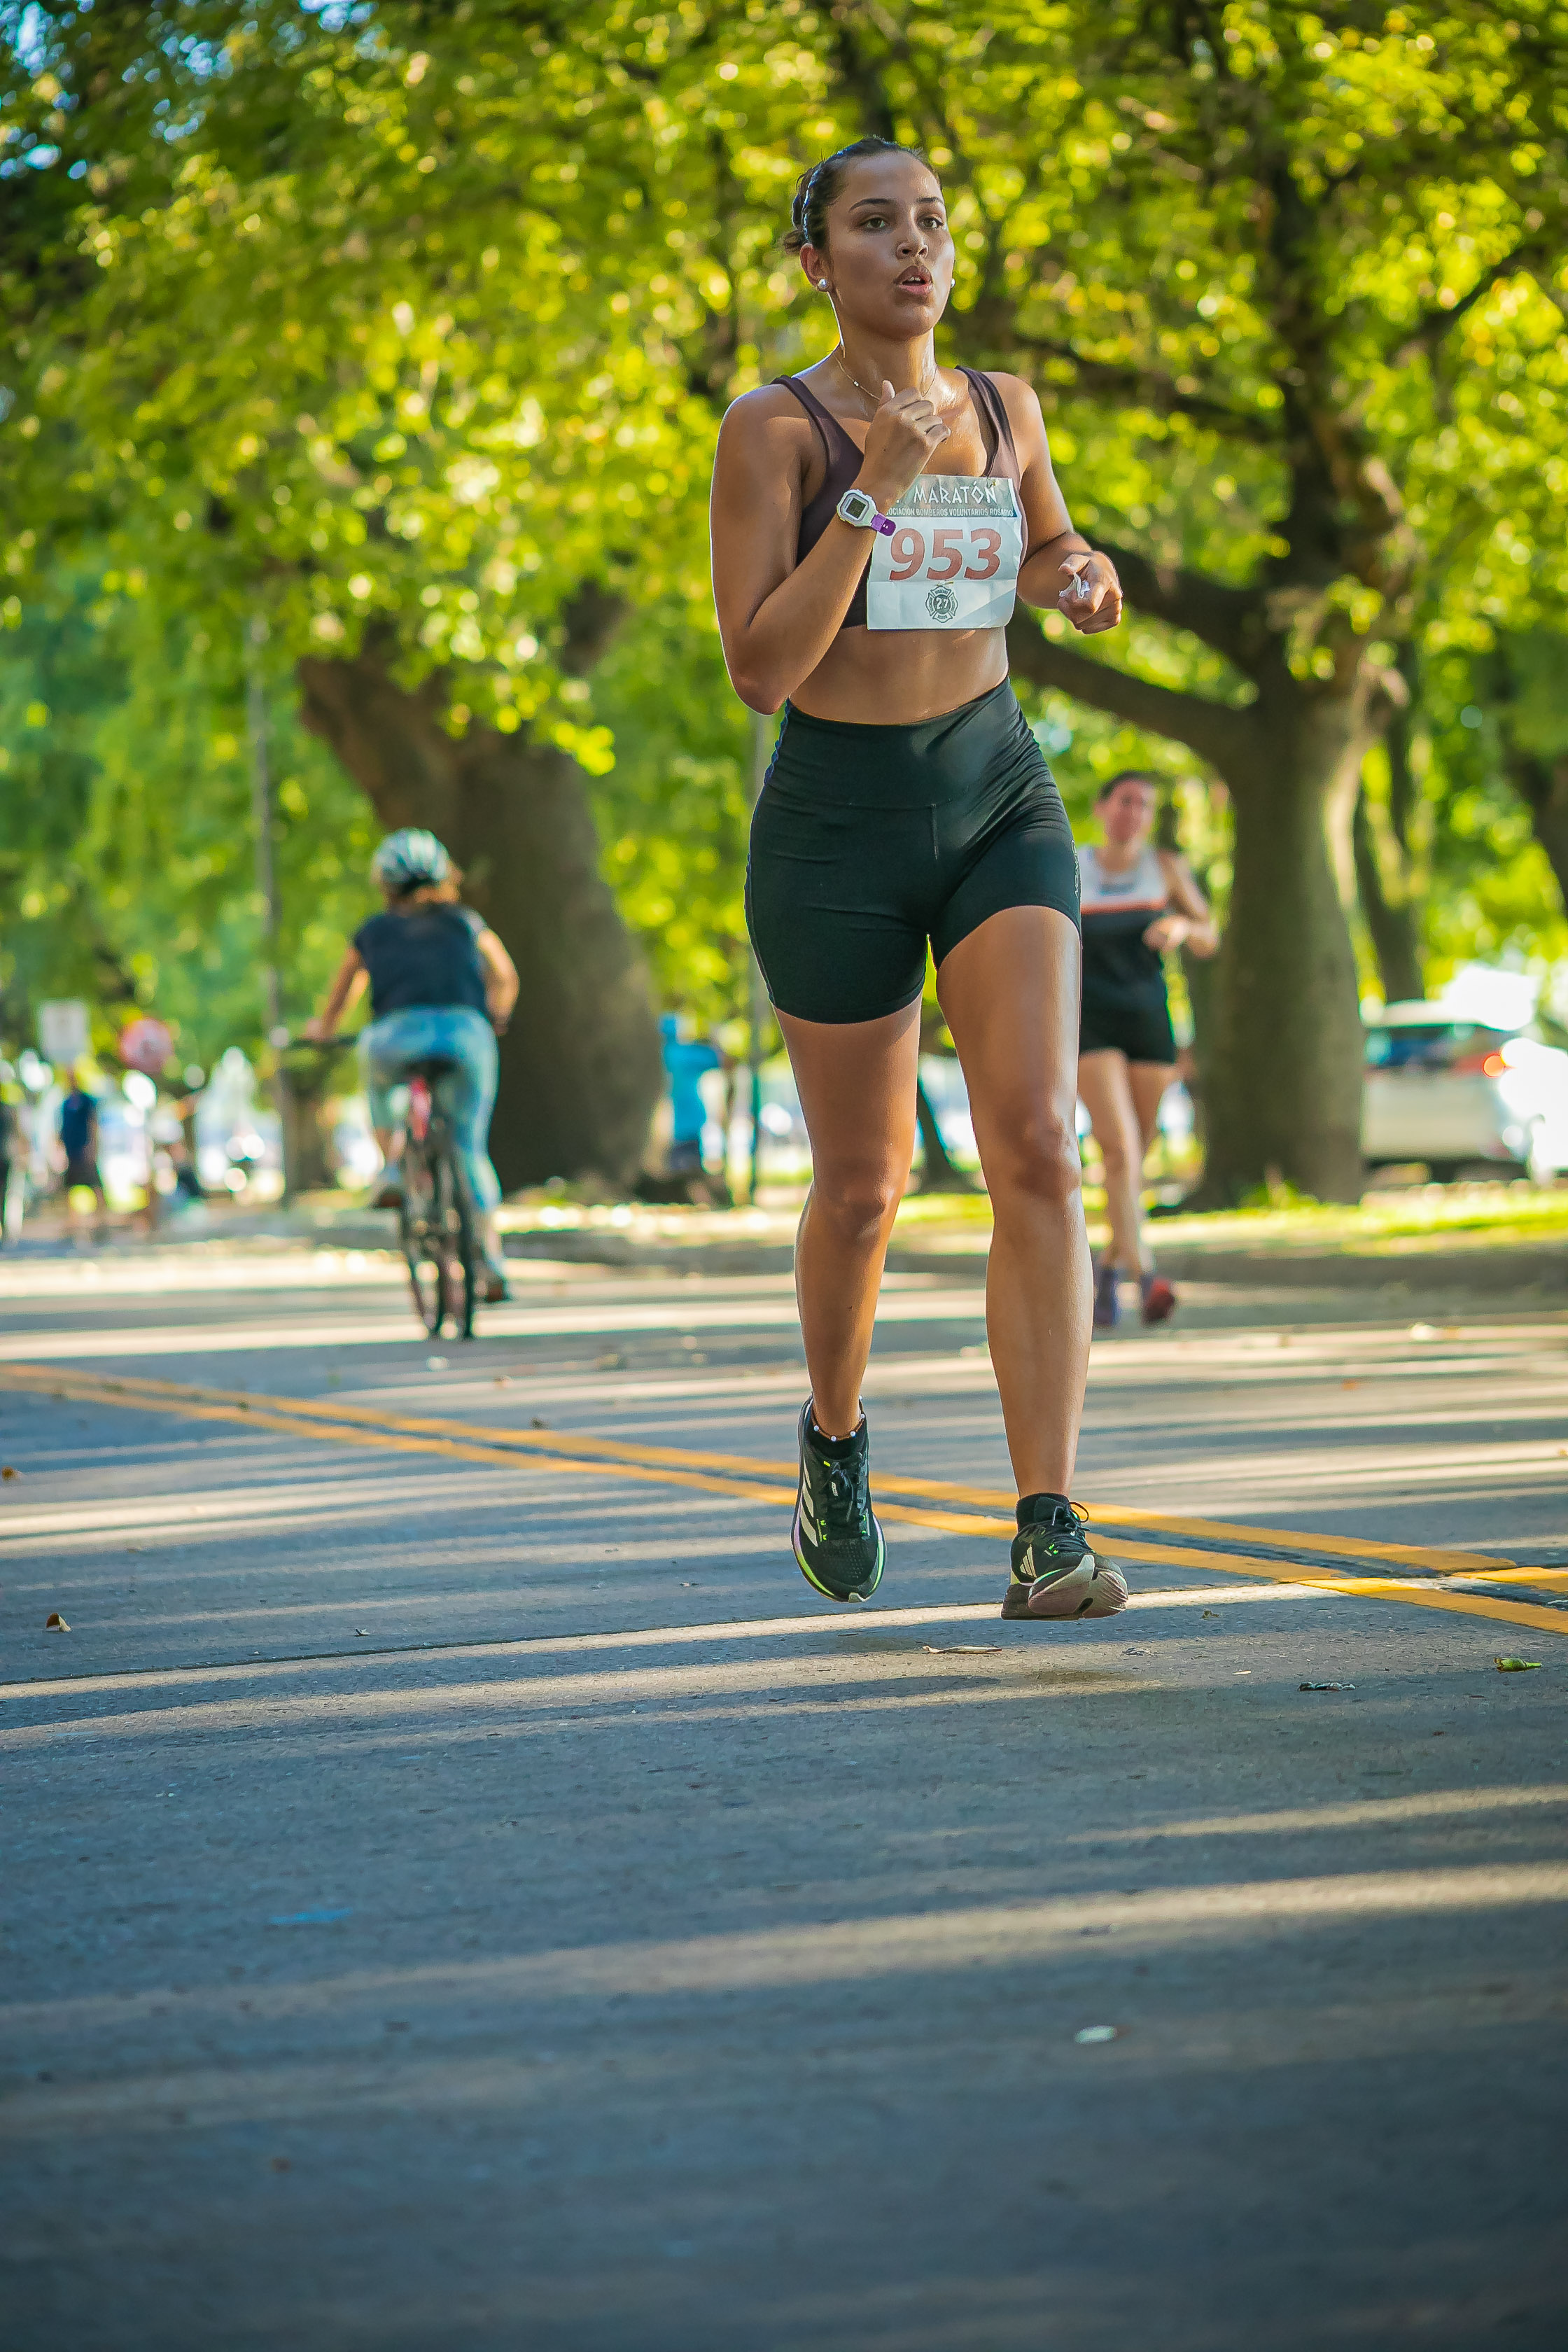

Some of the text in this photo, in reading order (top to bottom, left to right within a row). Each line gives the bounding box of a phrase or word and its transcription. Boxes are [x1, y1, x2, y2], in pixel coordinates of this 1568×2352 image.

[913, 481, 997, 505] MARATÓN
[886, 506, 1014, 517] OCIACIÓN BOMBEROS VOLUNTARIOS ROSARIO
[889, 528, 1002, 581] 953
